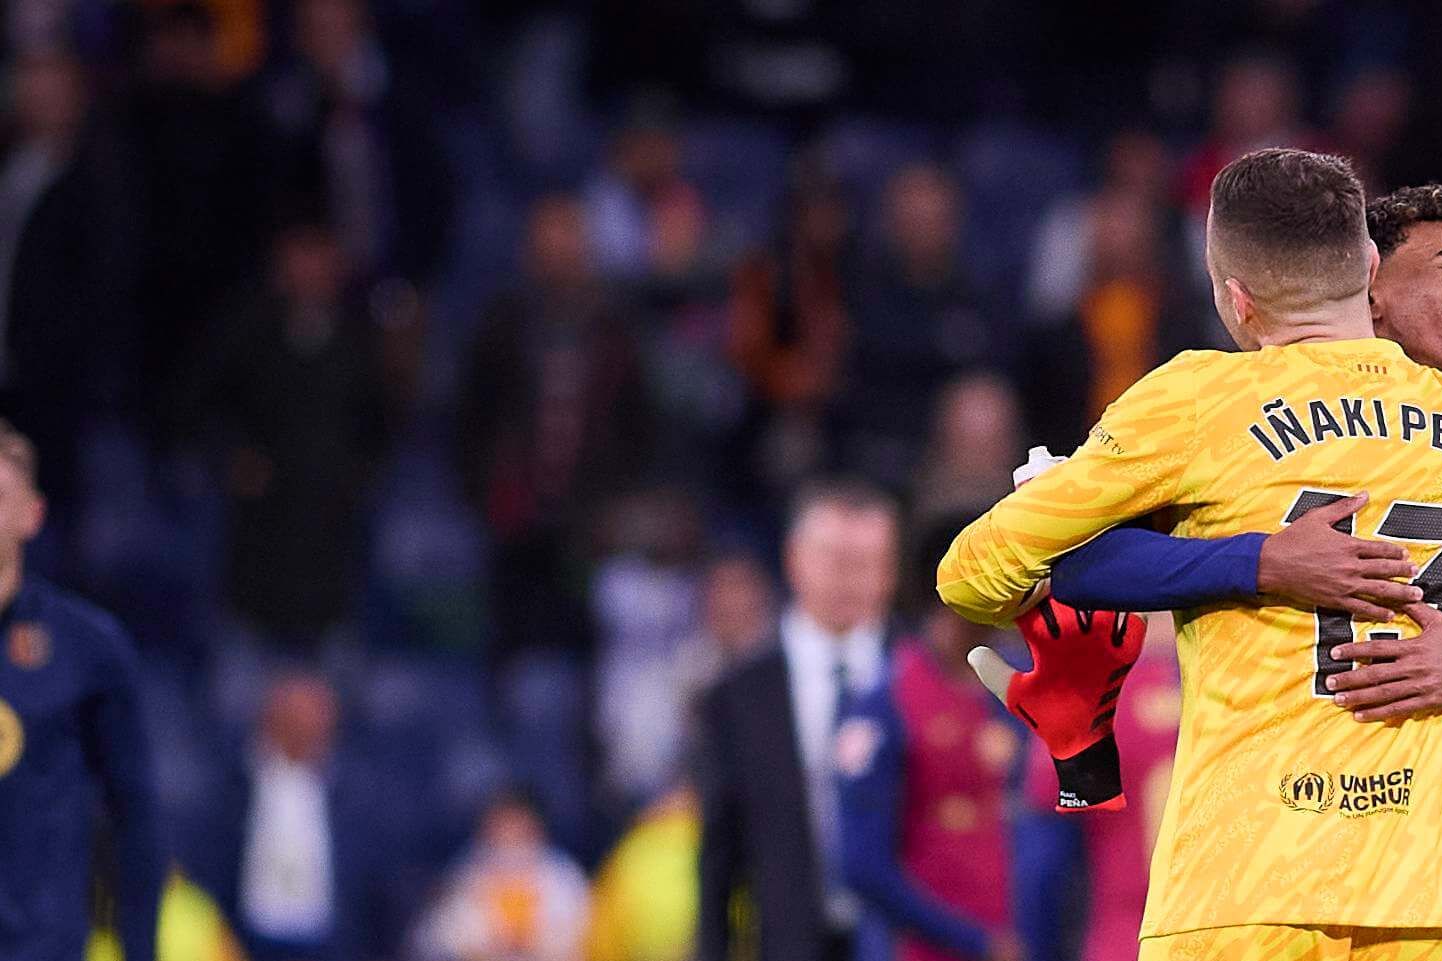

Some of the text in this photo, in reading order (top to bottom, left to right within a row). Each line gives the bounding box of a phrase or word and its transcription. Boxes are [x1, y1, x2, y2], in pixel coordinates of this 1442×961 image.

[1250, 397, 1388, 460] IÑAKI
[1340, 768, 1413, 793] UNHCR
[1060, 797, 1088, 807] PEÑA
[1339, 787, 1410, 811] ACNUR
